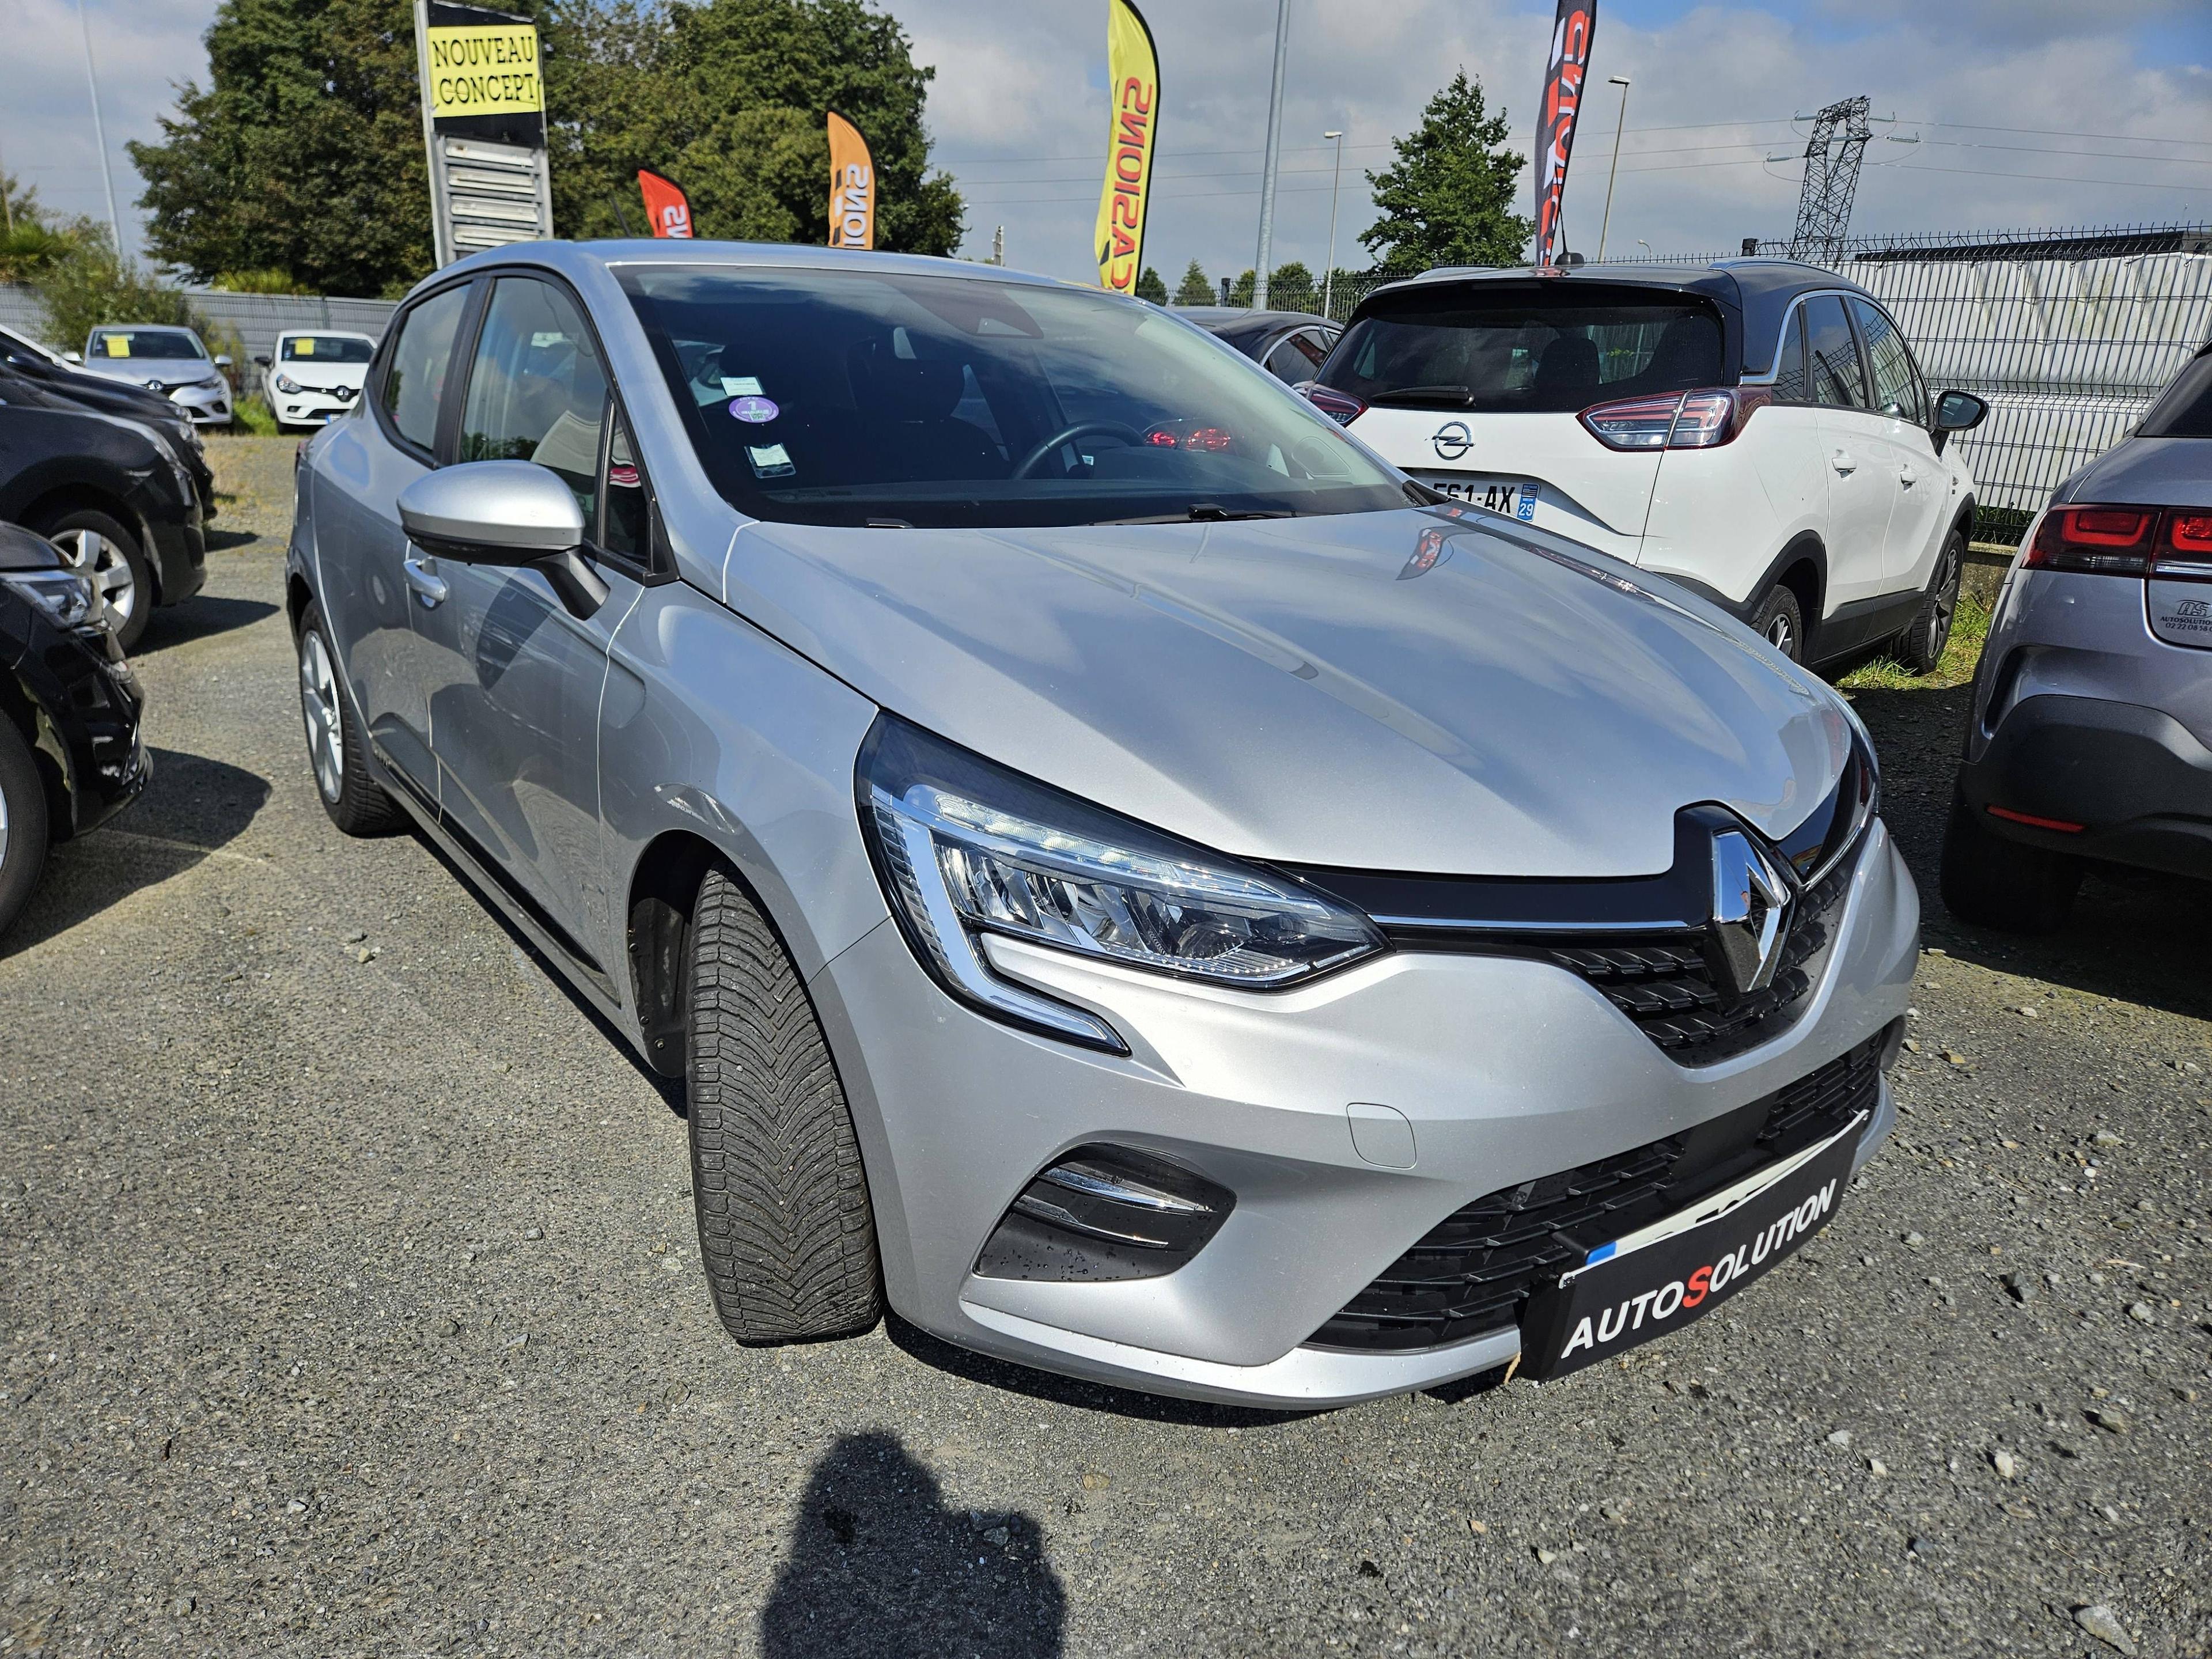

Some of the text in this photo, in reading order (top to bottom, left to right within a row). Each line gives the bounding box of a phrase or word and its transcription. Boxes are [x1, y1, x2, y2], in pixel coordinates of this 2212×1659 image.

[432, 36, 533, 67] NOUVEAU
[440, 73, 534, 105] CONCEPT
[748, 400, 756, 410] 1
[1518, 503, 1534, 517] 29
[2160, 616, 2212, 626] AUTOSOLUTIO
[1560, 1178, 1837, 1359] AUTOSOLUTION
